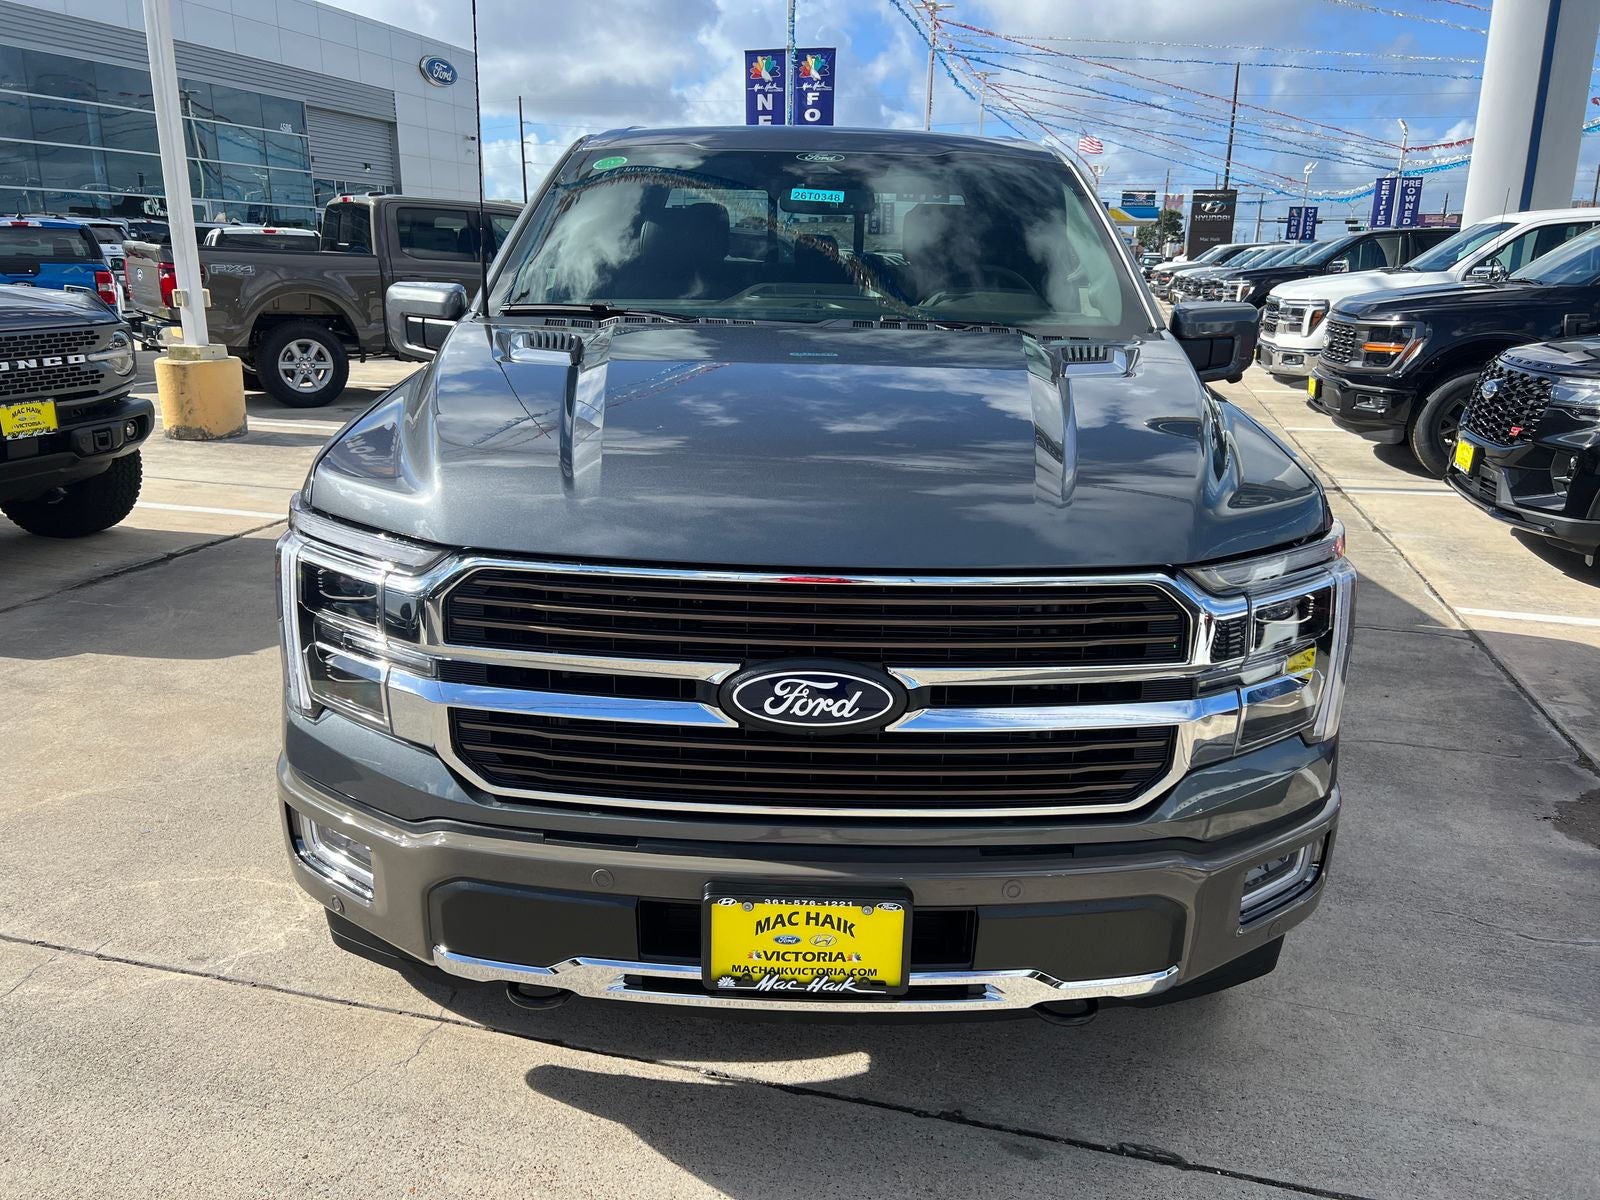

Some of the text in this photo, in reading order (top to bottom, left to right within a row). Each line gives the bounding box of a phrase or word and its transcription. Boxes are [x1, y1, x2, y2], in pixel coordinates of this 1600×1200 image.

[433, 62, 453, 81] Ford
[805, 153, 837, 161] Ford
[793, 191, 841, 202] 26T0348
[1376, 180, 1391, 225] CERTIFIED
[1402, 188, 1416, 225] OWNED
[1288, 220, 1298, 239] NEW
[1305, 209, 1315, 239] HYUNDAI
[12, 407, 25, 418] MAC
[763, 678, 863, 718] Ford
[754, 911, 856, 938] MAC HAIK
[762, 950, 847, 962] VICTORIA
[731, 964, 878, 977] MACHAIKVICTORIA.COM
[755, 974, 862, 992] Mac Haik
